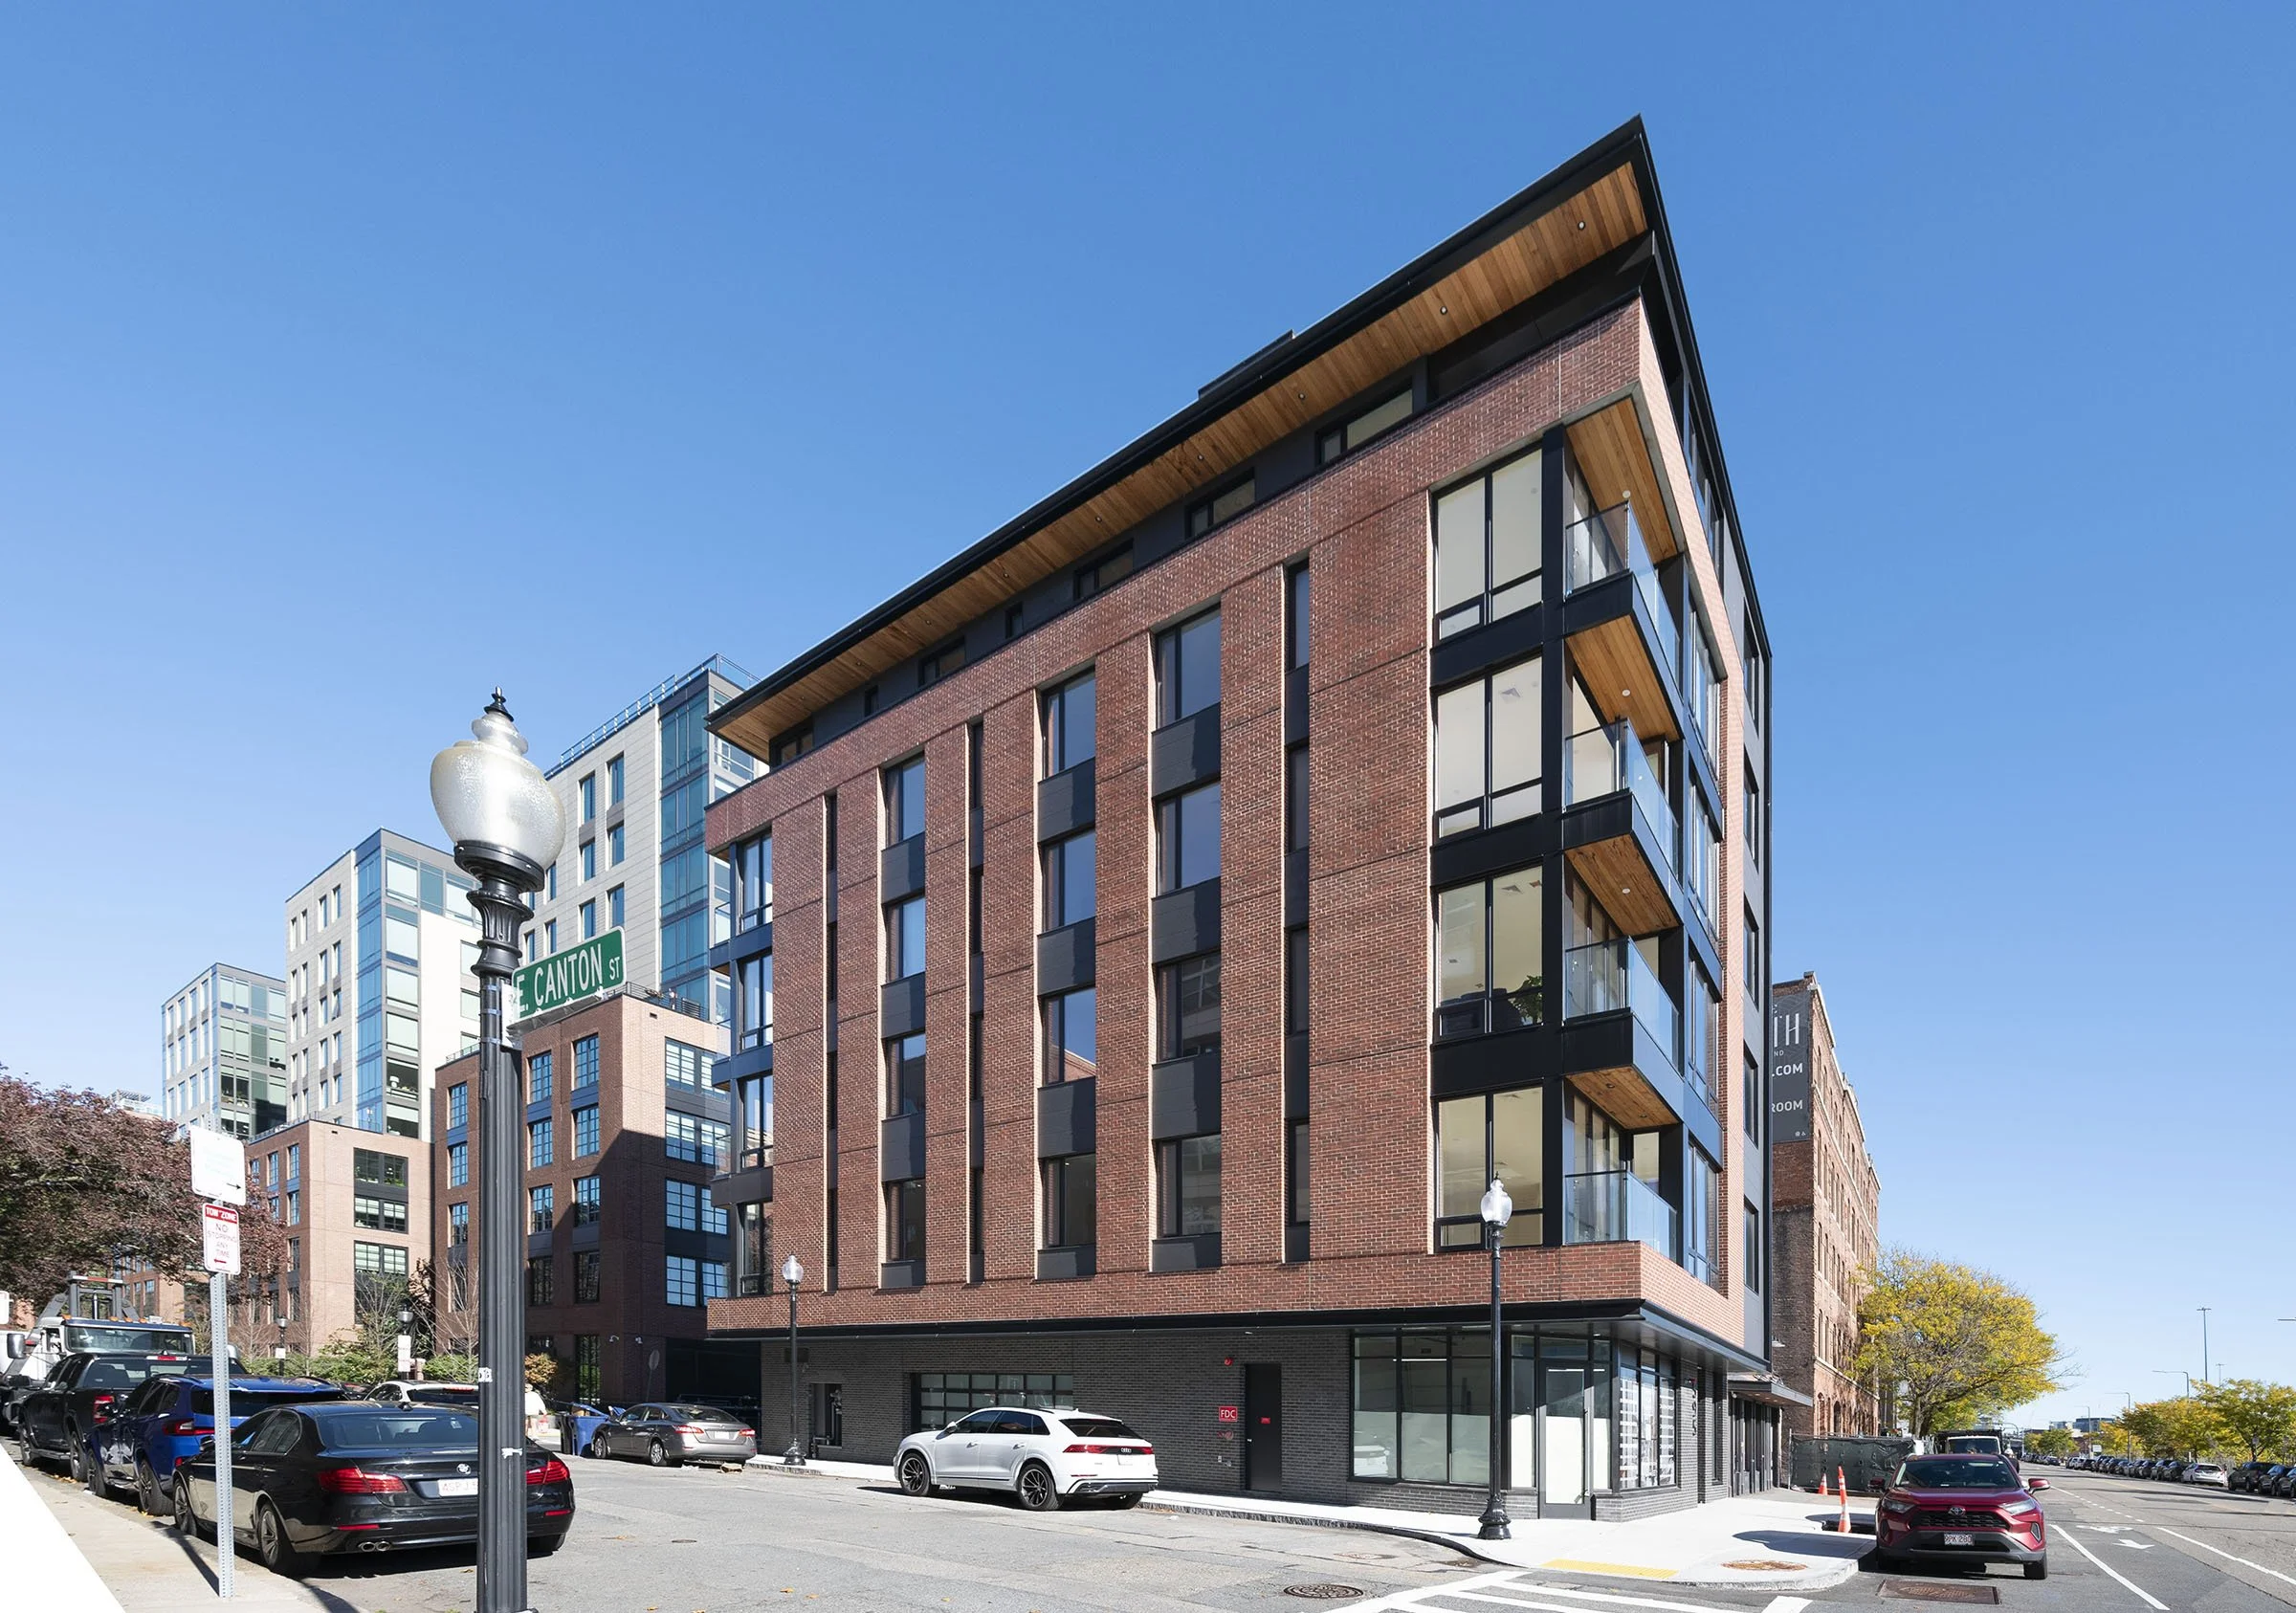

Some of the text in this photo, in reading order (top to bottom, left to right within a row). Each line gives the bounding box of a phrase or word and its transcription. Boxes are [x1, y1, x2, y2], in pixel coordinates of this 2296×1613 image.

[534, 943, 603, 1005] CANTON
[608, 957, 620, 981] ST
[1772, 1063, 1803, 1077] .COM
[206, 1206, 237, 1223] TOW ZONE
[215, 1223, 229, 1233] NO
[216, 1248, 230, 1258] TIME
[1220, 1409, 1236, 1418] FDC
